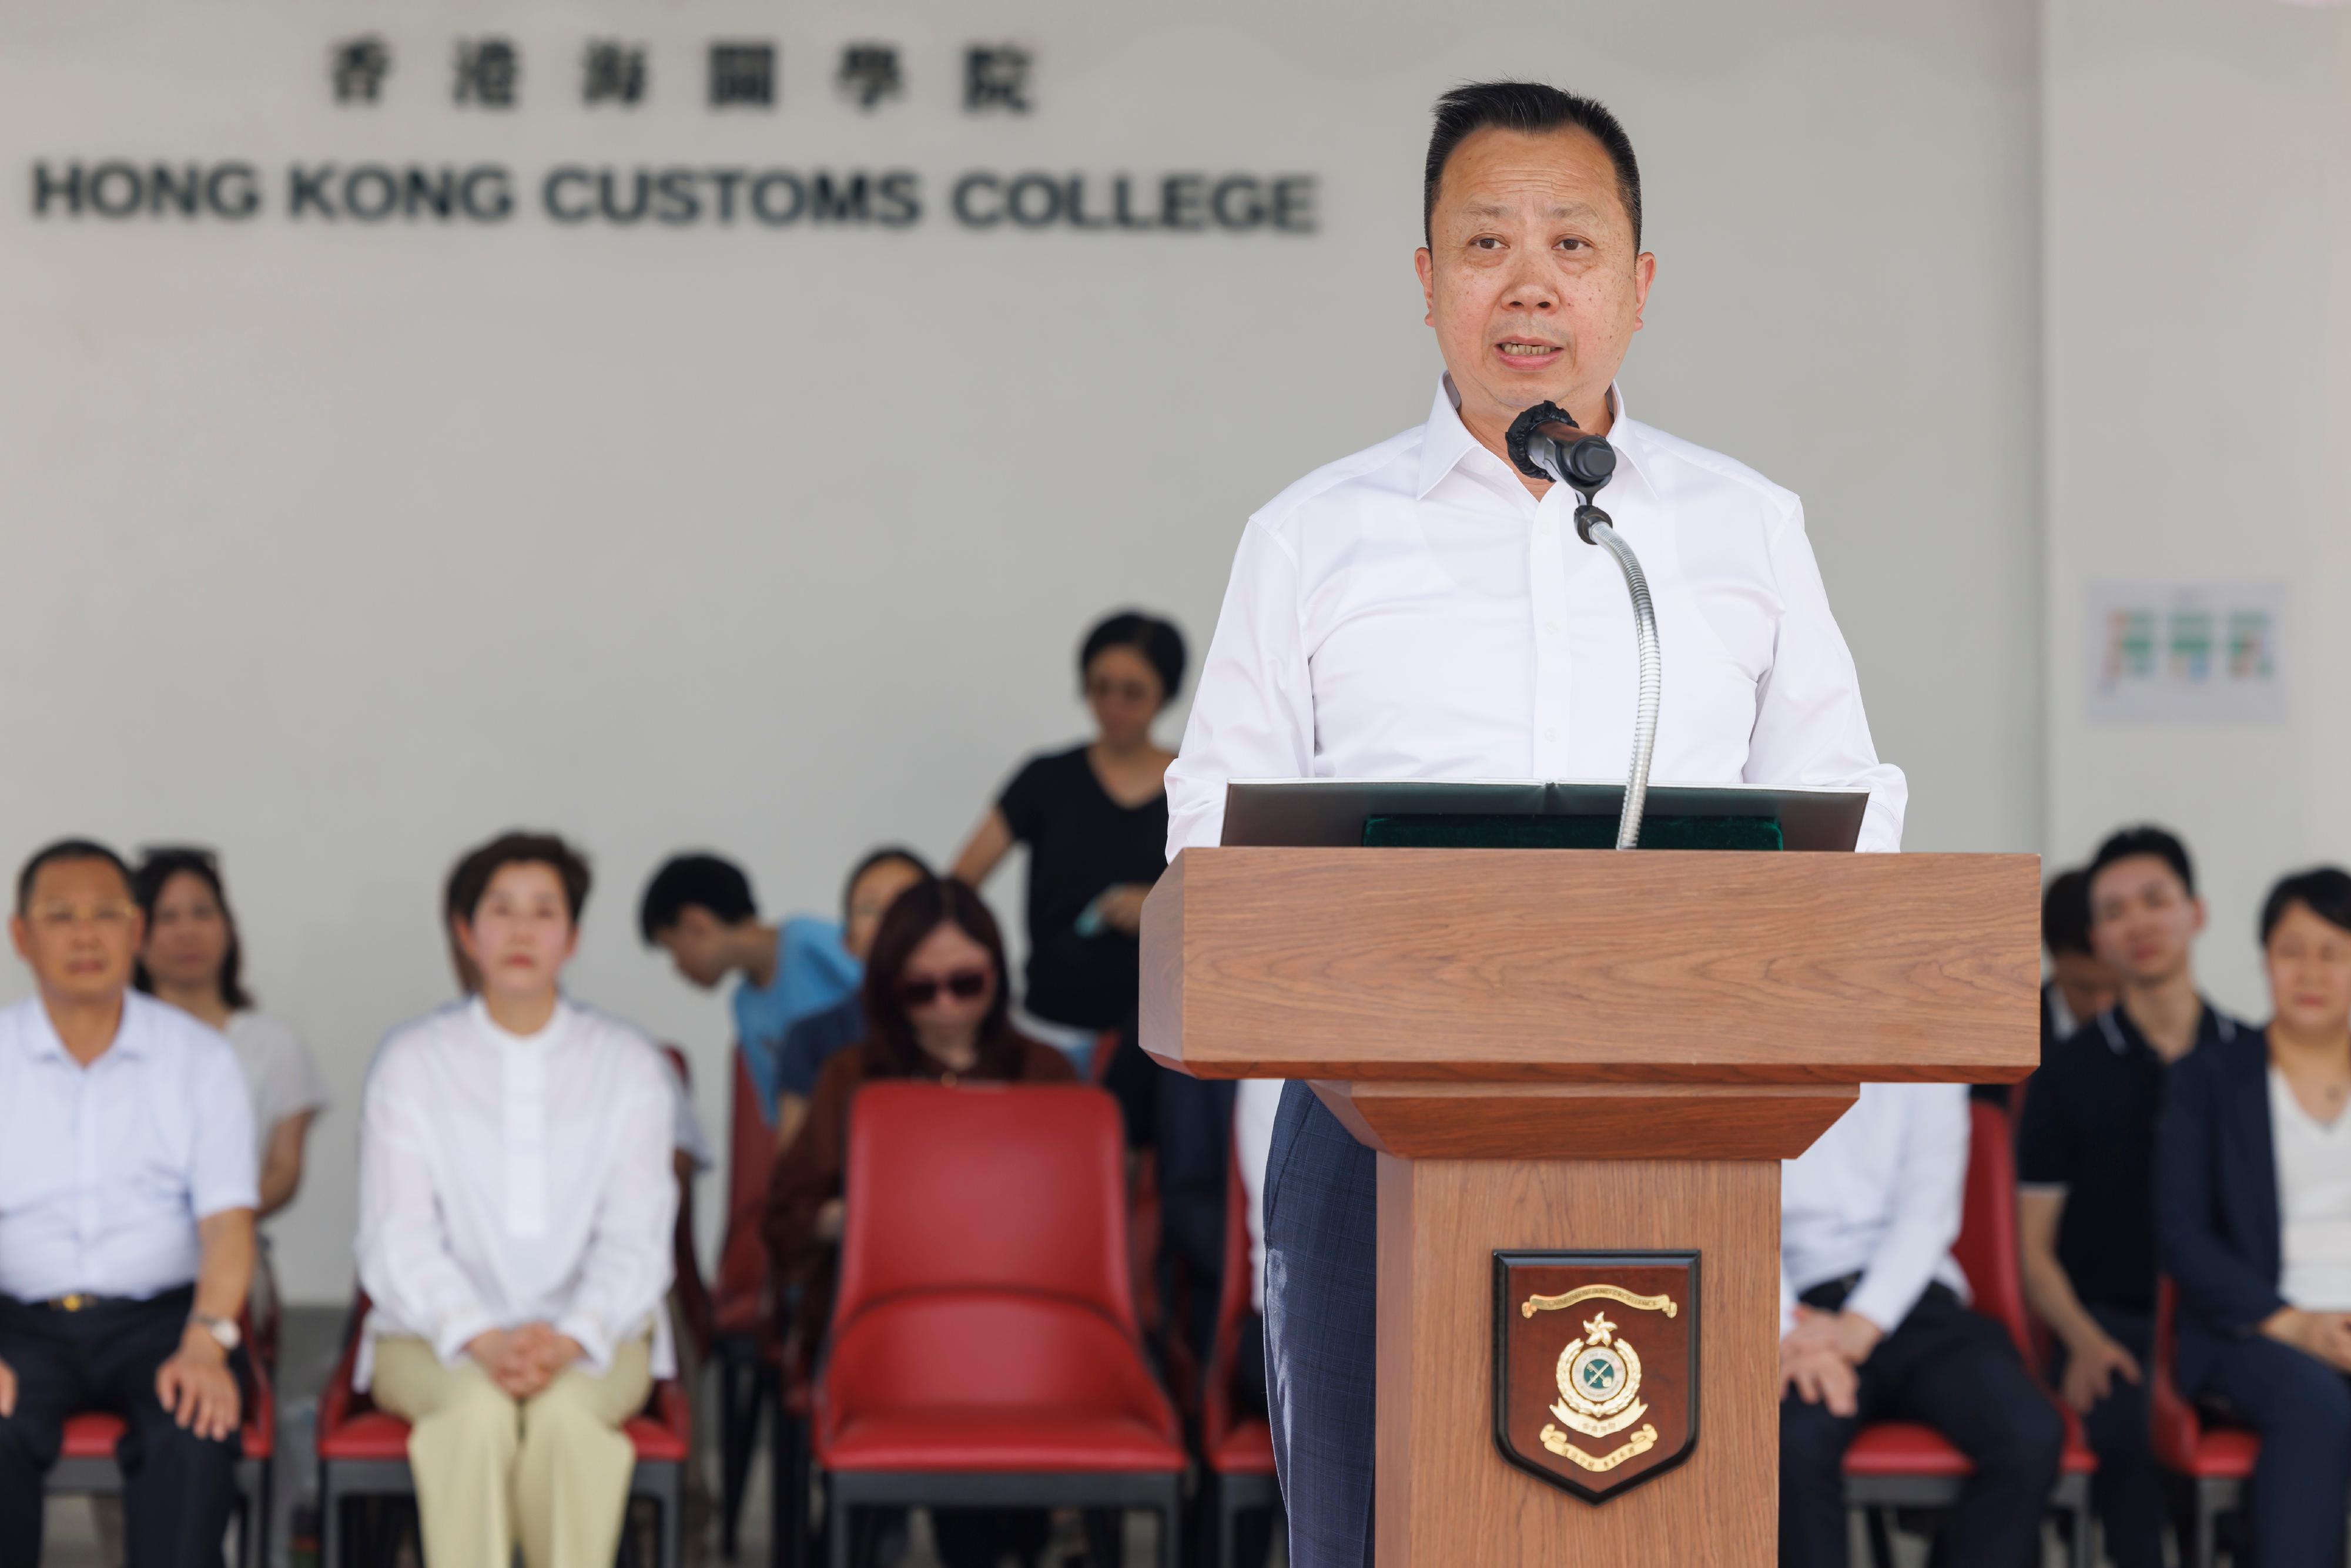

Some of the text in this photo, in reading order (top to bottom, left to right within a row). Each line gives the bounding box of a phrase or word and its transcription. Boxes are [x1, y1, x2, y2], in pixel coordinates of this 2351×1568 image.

[34, 163, 1314, 233] HONG KONG CUSTOMS COLLEGE
